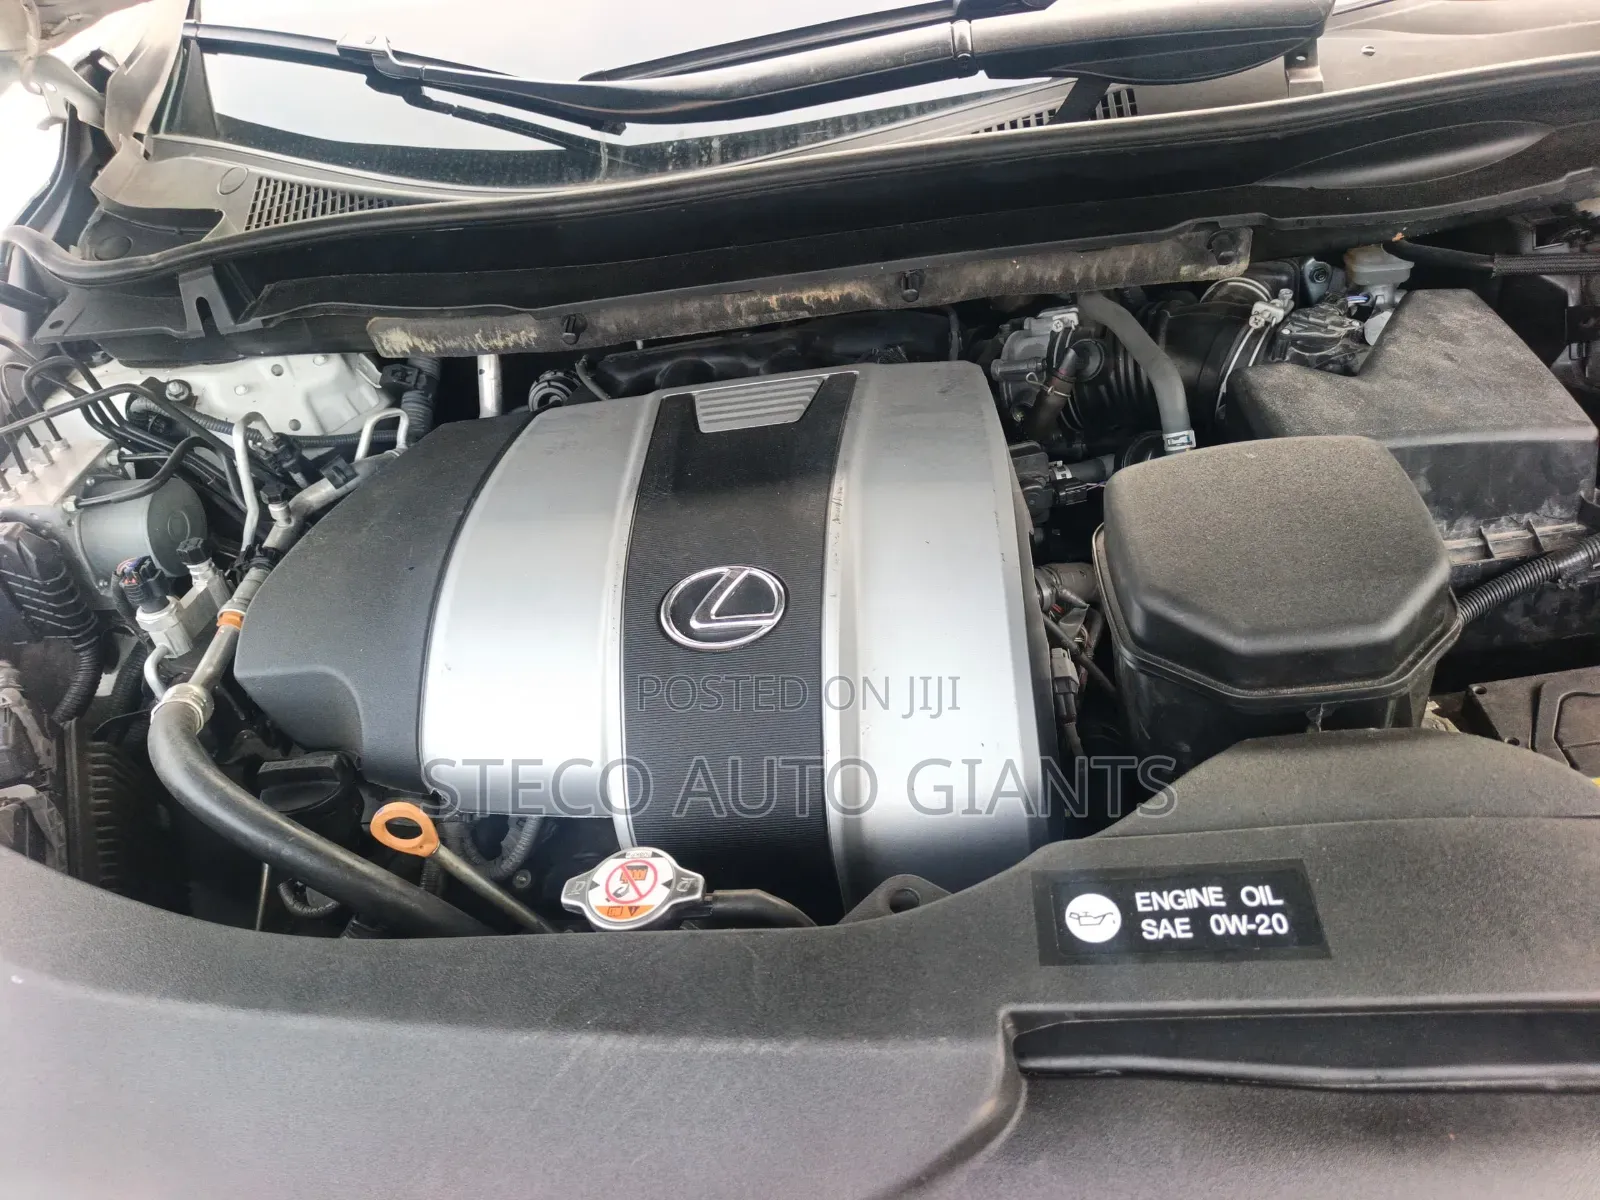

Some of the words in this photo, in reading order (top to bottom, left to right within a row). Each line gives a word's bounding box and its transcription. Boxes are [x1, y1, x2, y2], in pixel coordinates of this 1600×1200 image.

[1134, 886, 1227, 912] ENGINE
[1240, 885, 1284, 907] OIL
[1141, 917, 1193, 940] SAE
[1209, 912, 1289, 936] 0W-20
